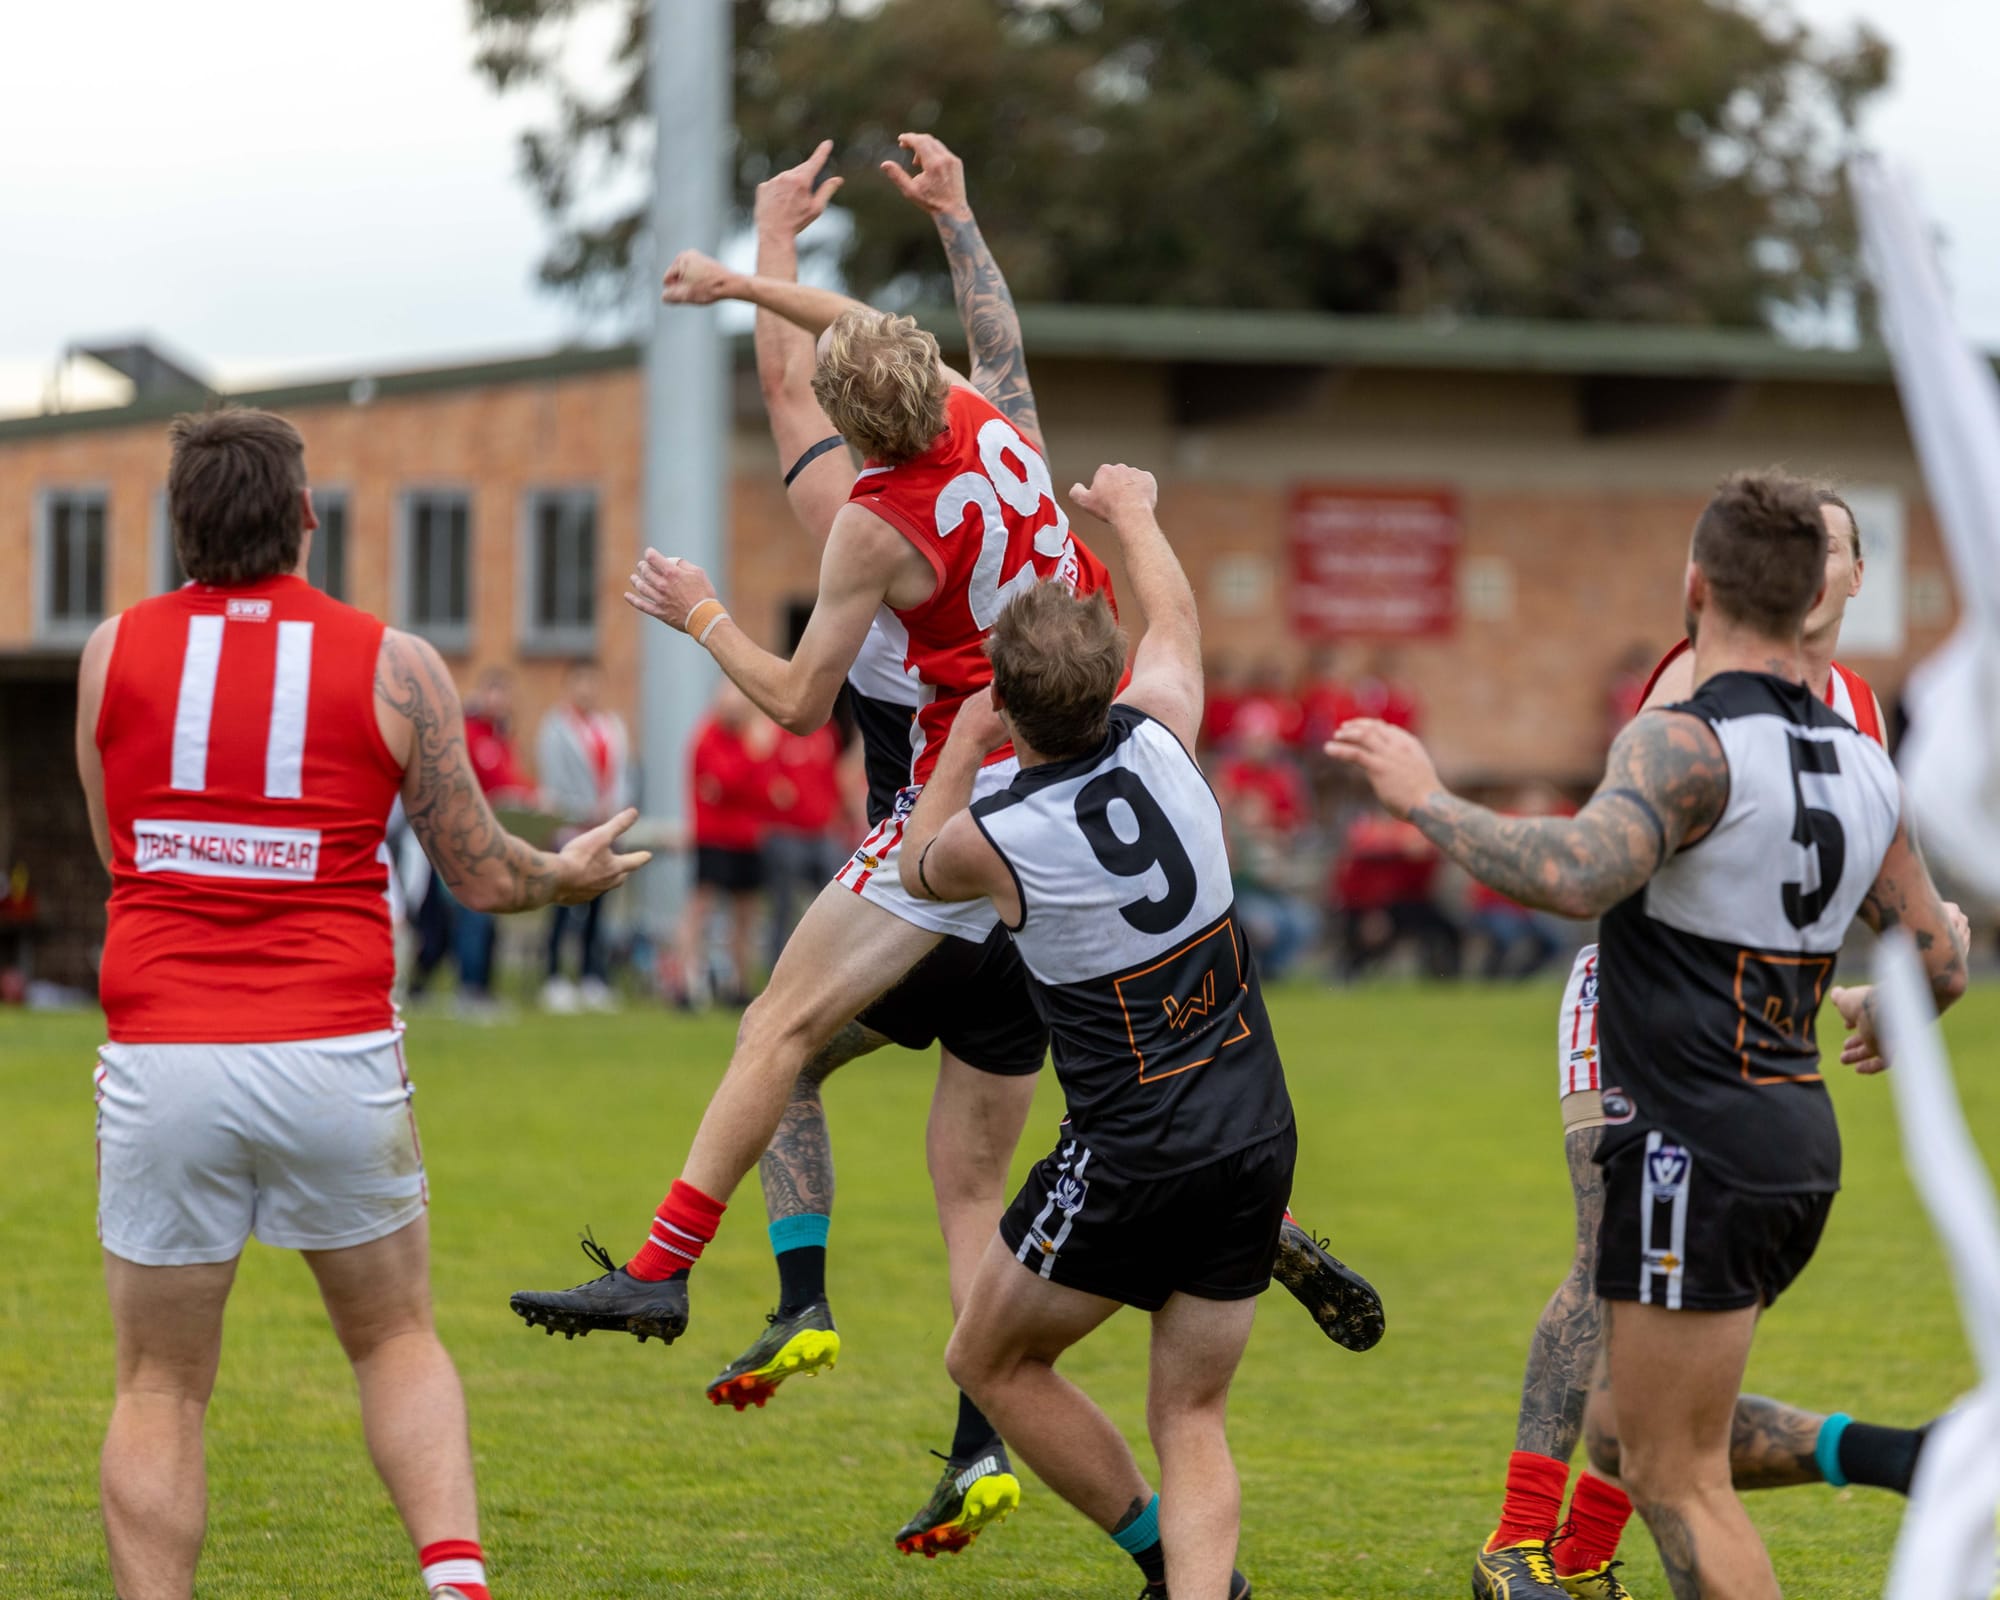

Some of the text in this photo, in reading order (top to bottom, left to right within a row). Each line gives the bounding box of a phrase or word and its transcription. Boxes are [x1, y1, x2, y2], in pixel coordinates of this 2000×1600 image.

[935, 419, 1069, 632] 29
[171, 615, 314, 799] 11
[140, 833, 313, 869] TRAF MENS WEAR
[1074, 766, 1198, 935] 9
[1781, 729, 1846, 931] 5
[955, 1455, 998, 1496] PUMA
